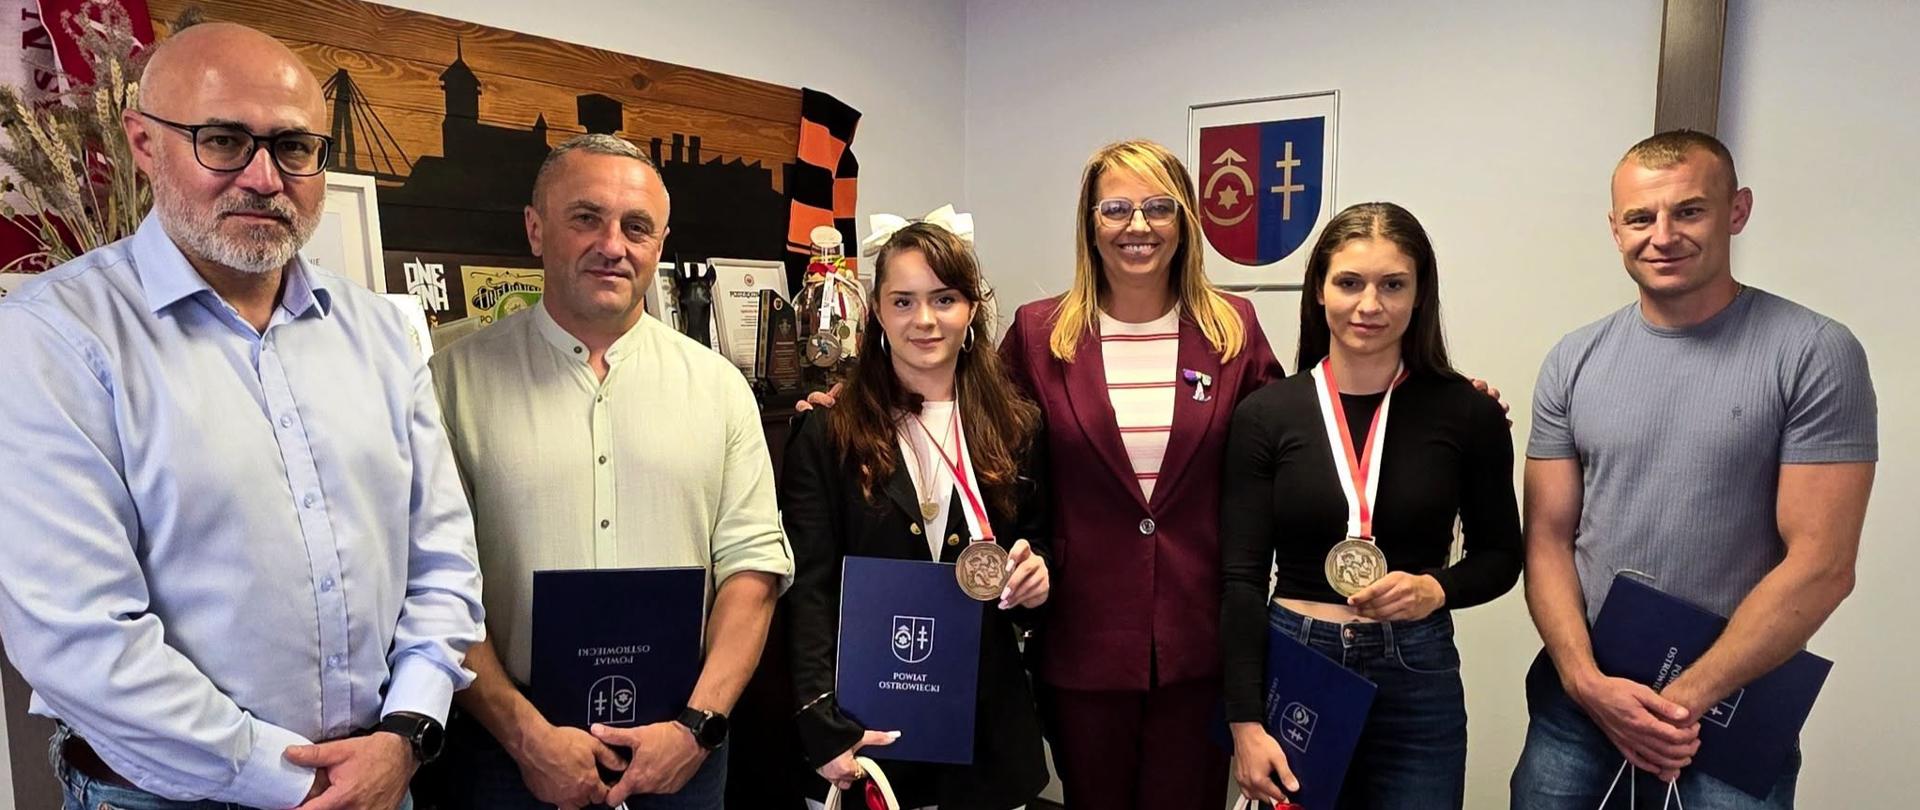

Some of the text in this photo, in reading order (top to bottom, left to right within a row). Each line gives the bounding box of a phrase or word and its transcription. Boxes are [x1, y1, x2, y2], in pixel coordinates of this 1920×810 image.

[578, 644, 651, 657] OSTROWIECKI
[594, 655, 634, 666] POWIAT
[893, 671, 928, 682] POWIAT
[878, 680, 940, 693] OSTROWIECKI
